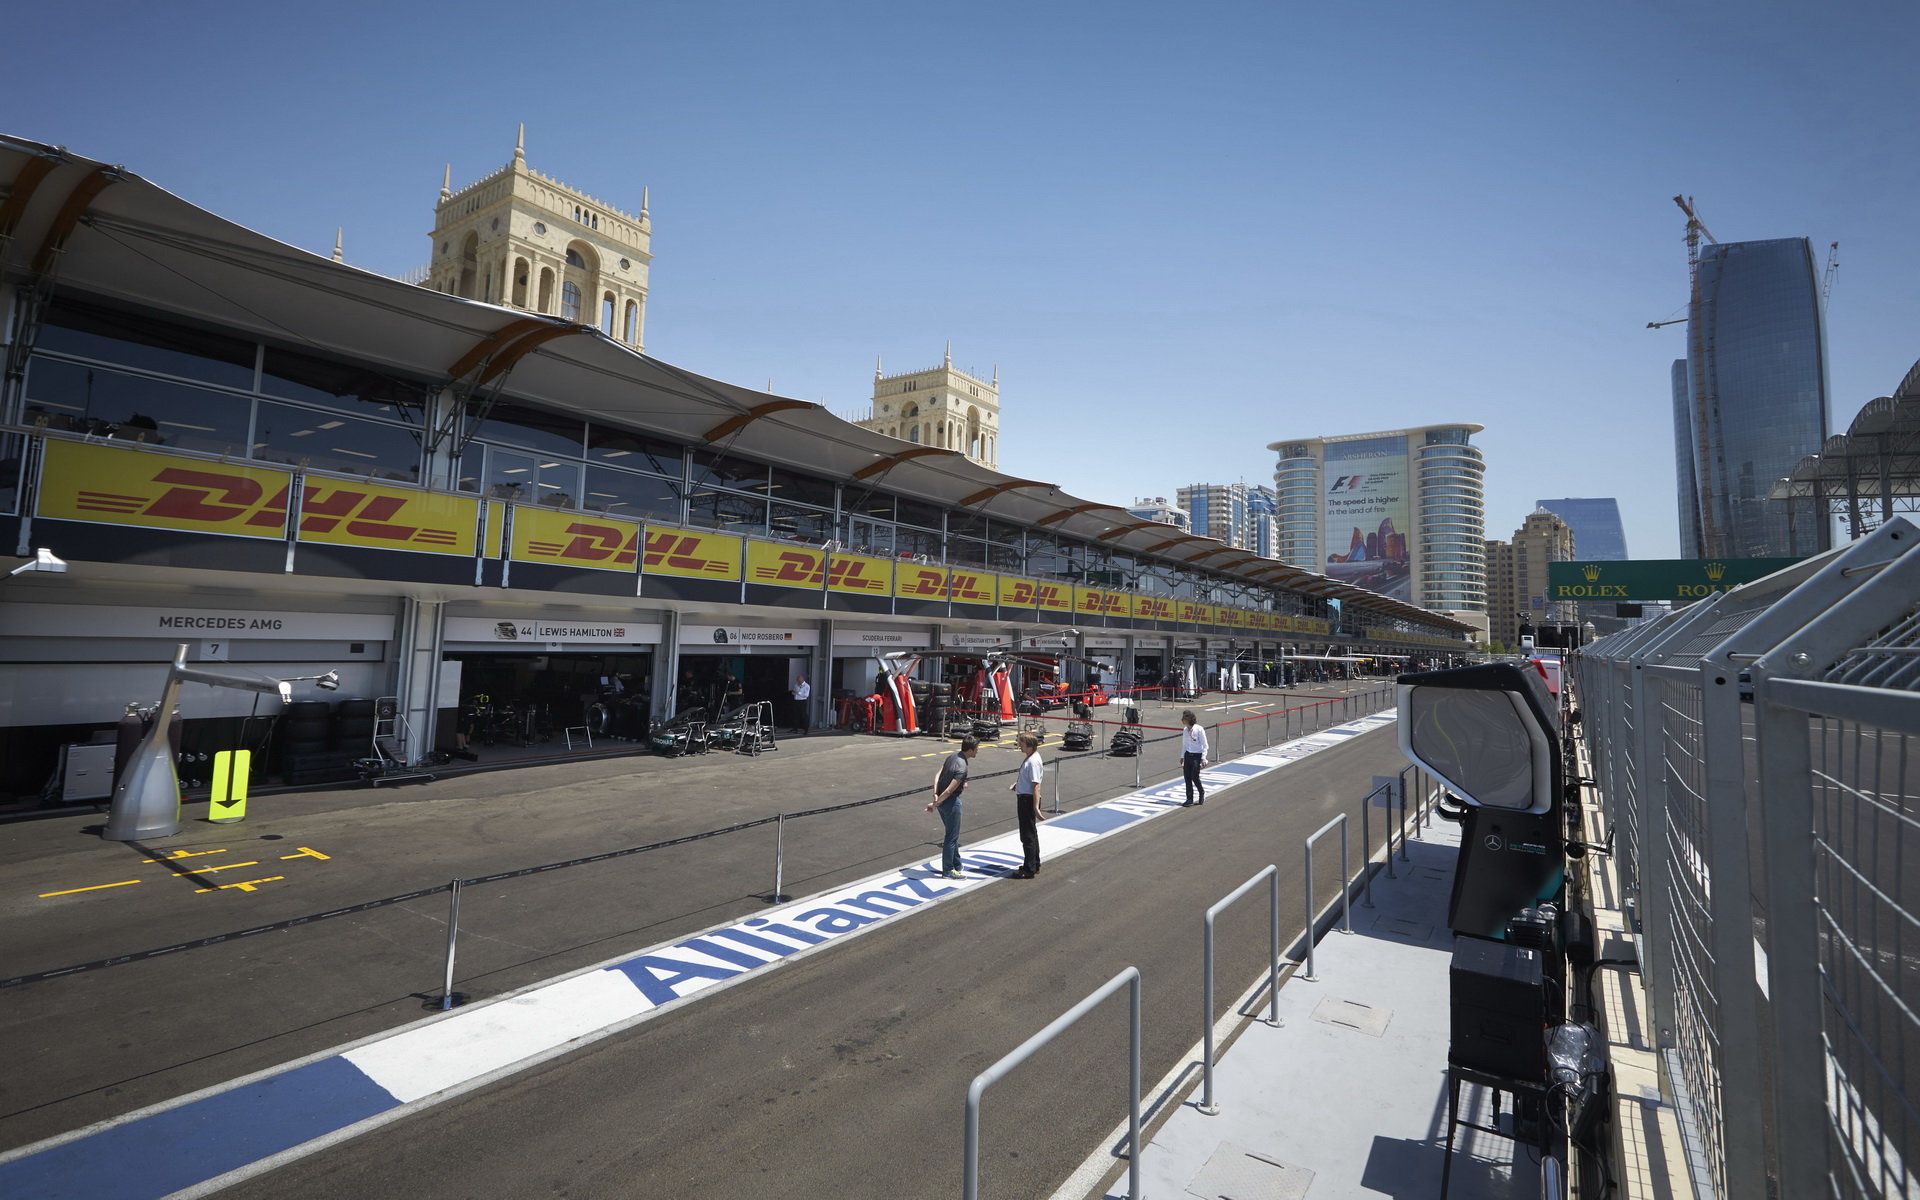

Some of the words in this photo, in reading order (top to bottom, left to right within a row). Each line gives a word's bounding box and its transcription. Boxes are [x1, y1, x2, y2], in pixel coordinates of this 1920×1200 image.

[142, 467, 417, 541] DHL
[1343, 498, 1366, 506] speed
[1376, 496, 1399, 504] higher
[560, 523, 708, 570] DHL
[777, 552, 869, 588] DHL
[915, 571, 981, 600] DHL
[1557, 585, 1629, 597] ROLEX
[1014, 583, 1062, 607] DHL
[1085, 592, 1121, 612] DHL
[1140, 600, 1169, 617] DHL
[1183, 605, 1208, 621] DHL
[159, 616, 246, 629] MERCEDES
[250, 618, 282, 630] AMG
[1220, 610, 1239, 624] DHL
[521, 627, 532, 635] 44
[540, 627, 567, 637] LEWIS
[570, 628, 612, 637] HAMILTON
[757, 633, 784, 641] ROSBERG
[862, 634, 883, 642] SCUDERIA
[211, 643, 219, 655] 7
[604, 868, 959, 1006] Allianz
